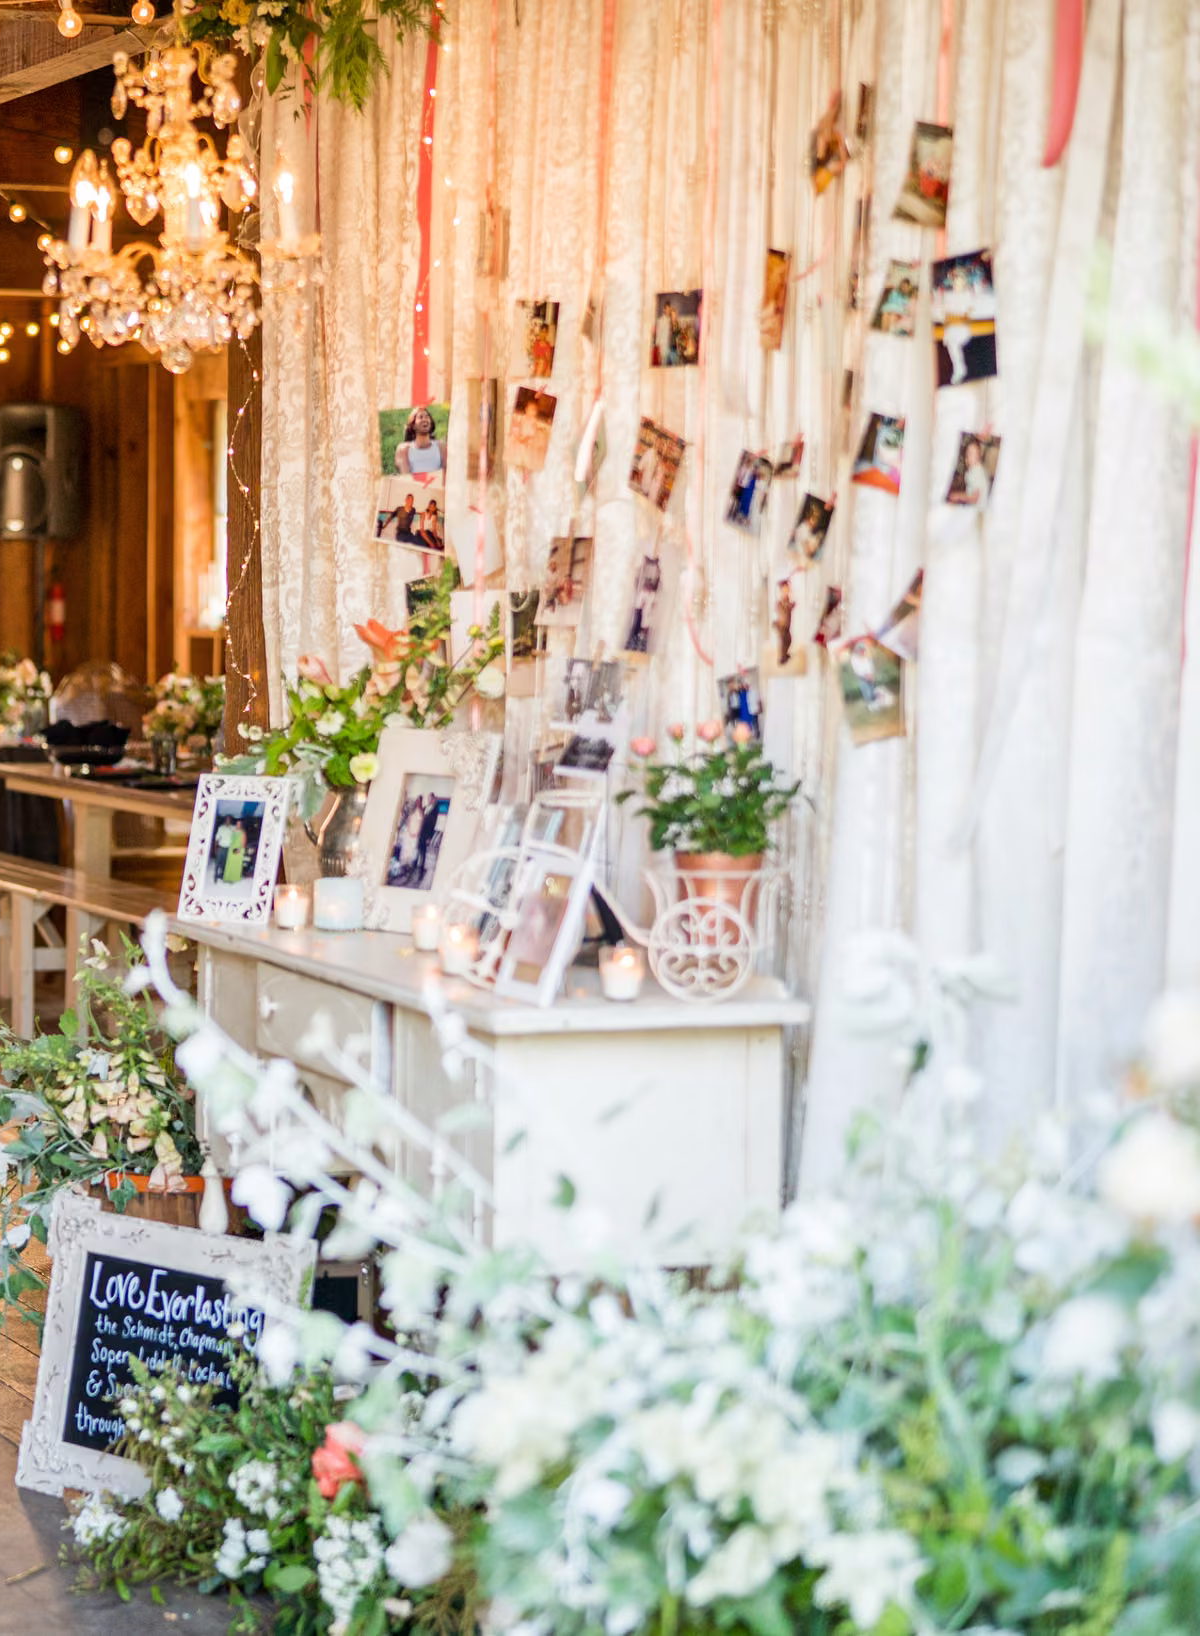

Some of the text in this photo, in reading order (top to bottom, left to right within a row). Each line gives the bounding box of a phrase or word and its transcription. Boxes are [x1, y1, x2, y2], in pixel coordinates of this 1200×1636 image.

[90, 1261, 265, 1351] Love Everlasting
[95, 1313, 118, 1336] the
[85, 1369, 103, 1398] &
[74, 1401, 126, 1445] through
